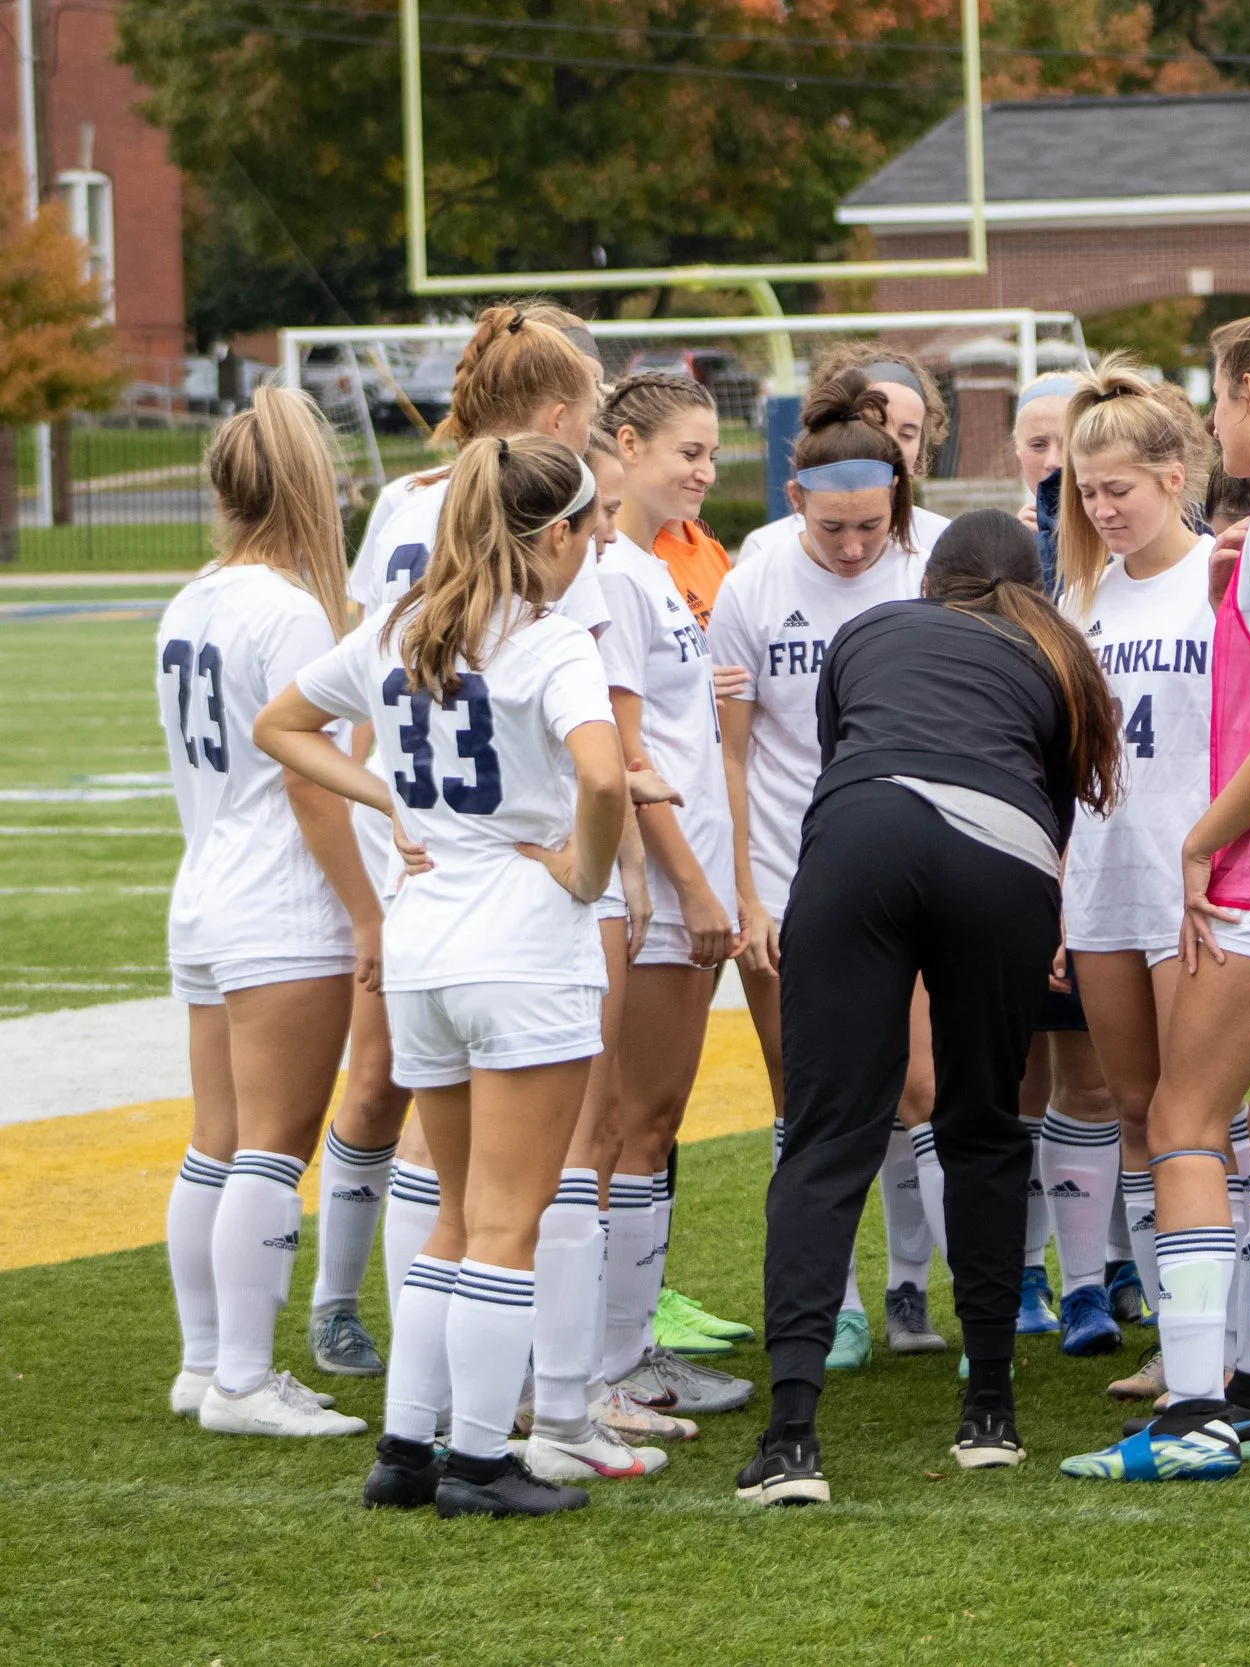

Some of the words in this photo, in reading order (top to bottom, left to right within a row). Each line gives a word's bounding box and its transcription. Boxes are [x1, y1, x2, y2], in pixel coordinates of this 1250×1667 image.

[784, 620, 810, 628] adidas
[1092, 639, 1208, 676] ANKLIN
[163, 639, 230, 775] 23
[382, 667, 503, 815] 33
